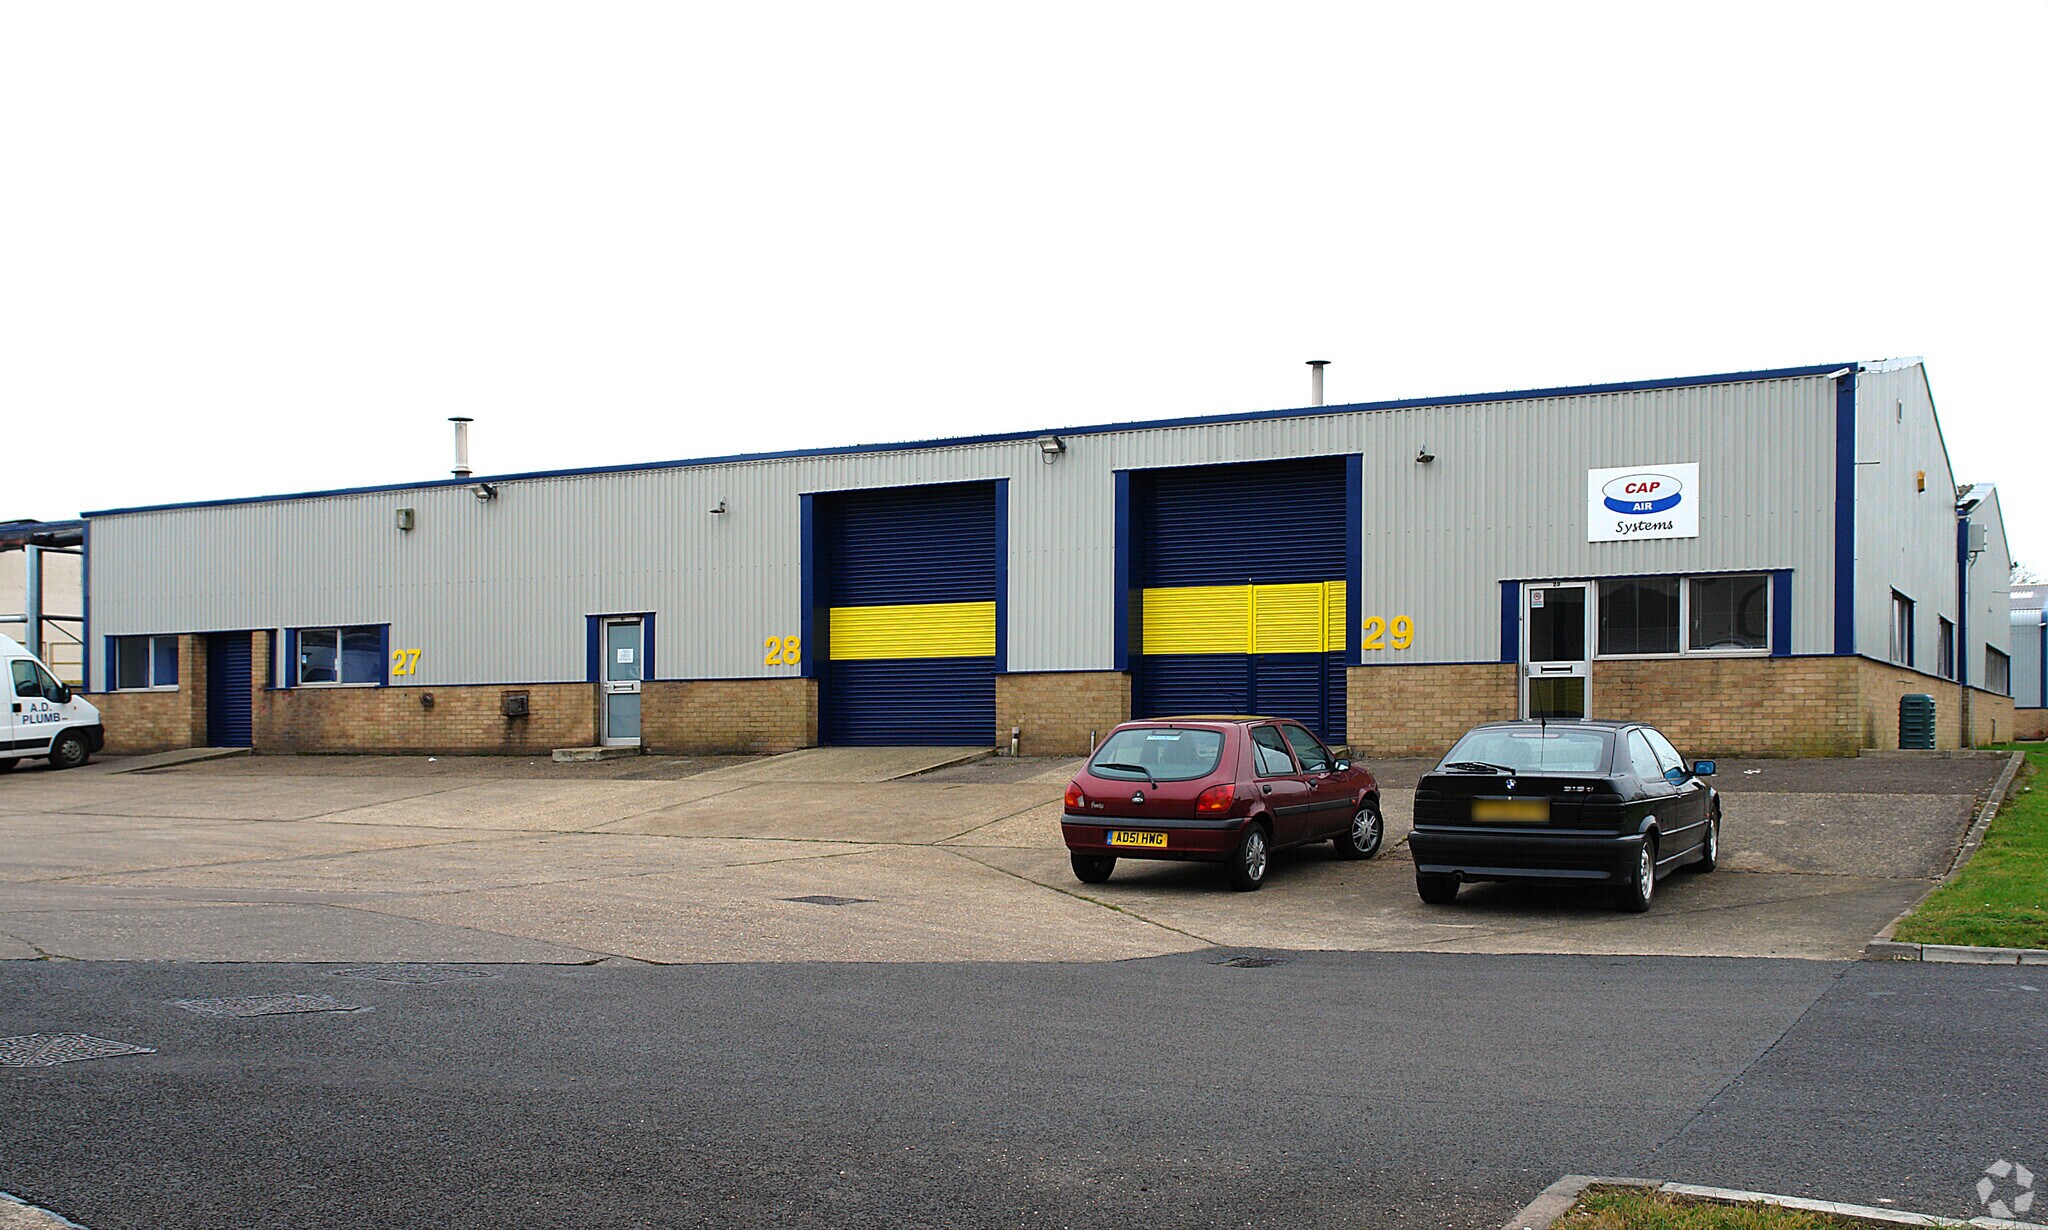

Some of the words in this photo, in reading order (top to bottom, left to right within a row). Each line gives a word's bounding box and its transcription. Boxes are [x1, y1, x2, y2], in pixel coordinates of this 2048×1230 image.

[1625, 482, 1660, 494] CAP
[1633, 502, 1653, 511] AIR
[1615, 520, 1674, 535] Systems
[1362, 615, 1415, 650] 29
[764, 635, 801, 666] 28
[392, 649, 421, 676] 27
[30, 702, 52, 712] A.D.
[22, 712, 61, 724] PLUMB
[1141, 833, 1163, 845] HWG
